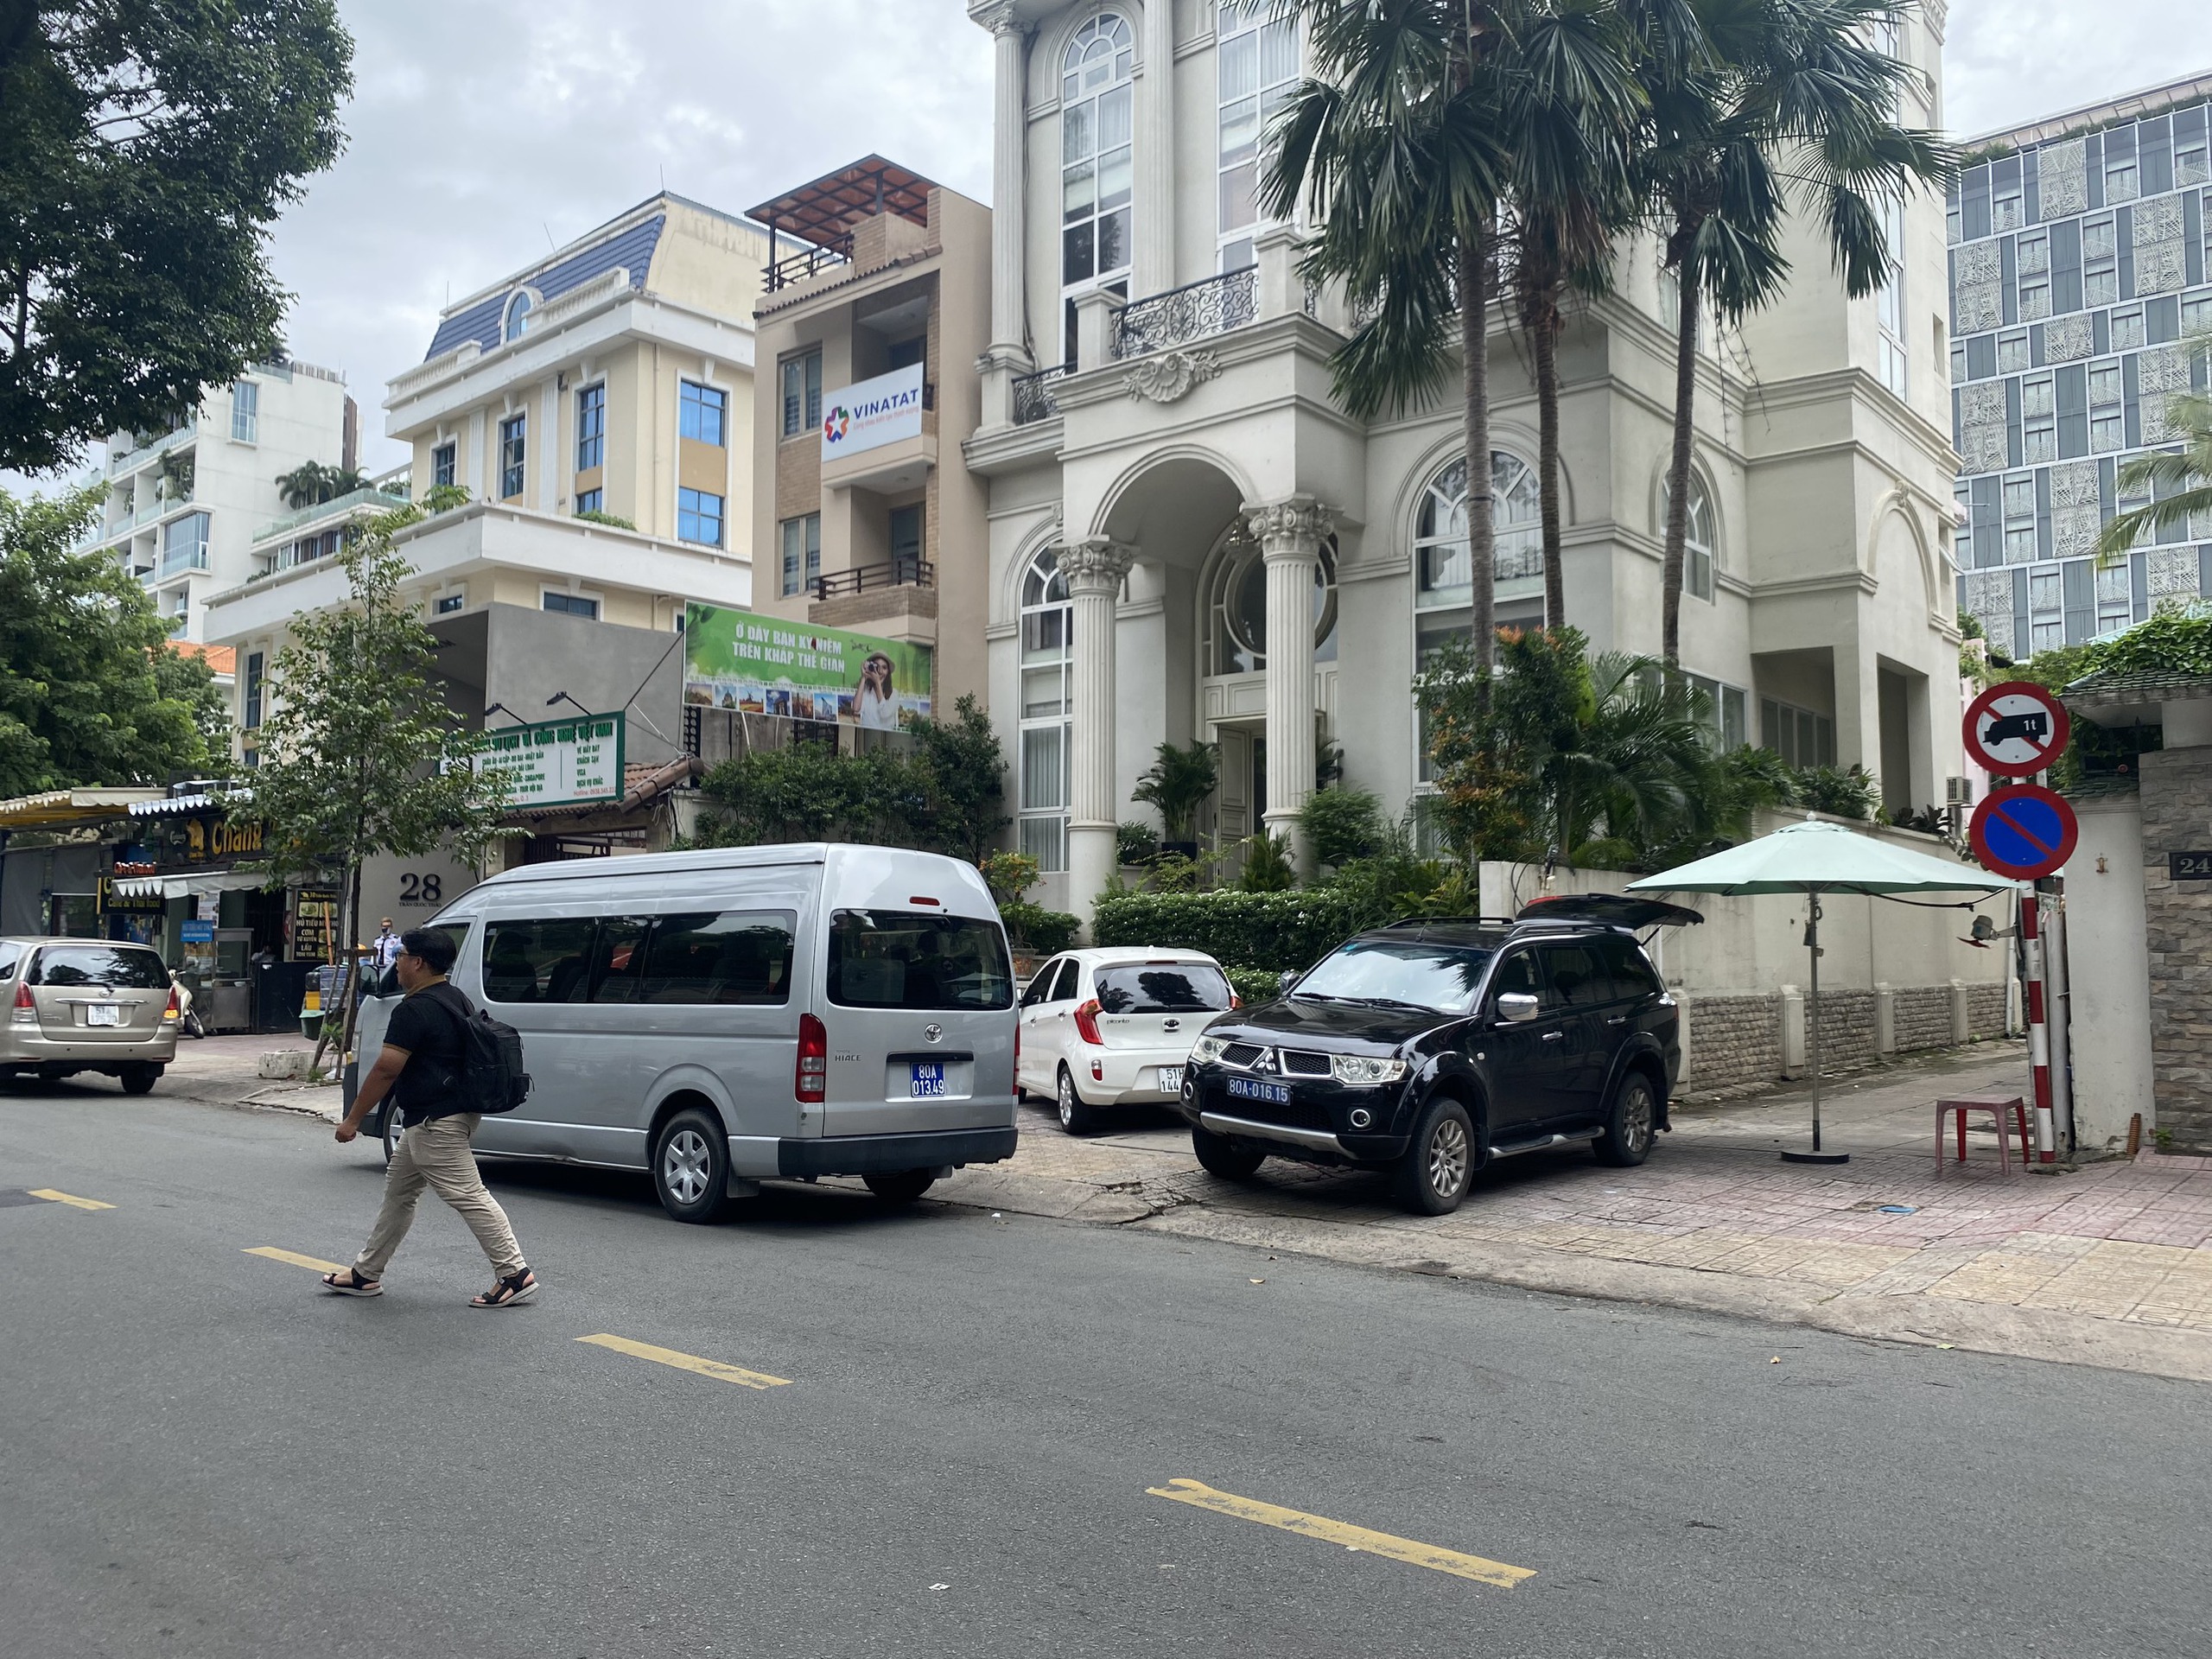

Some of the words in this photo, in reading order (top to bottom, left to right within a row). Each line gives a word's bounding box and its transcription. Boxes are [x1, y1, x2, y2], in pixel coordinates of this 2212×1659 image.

[854, 387, 919, 419] VINATAT
[732, 640, 761, 661] TRÊN
[820, 656, 845, 674] GIAN
[577, 721, 594, 742] VIỆT
[594, 721, 613, 738] NAM
[2023, 719, 2037, 731] 1t
[2180, 857, 2212, 874] 24
[400, 873, 442, 900] 28
[918, 1064, 937, 1079] 80A
[912, 1079, 944, 1096] 013.49
[1161, 1080, 1179, 1091] 144
[1229, 1078, 1288, 1103] 80A-016.15
